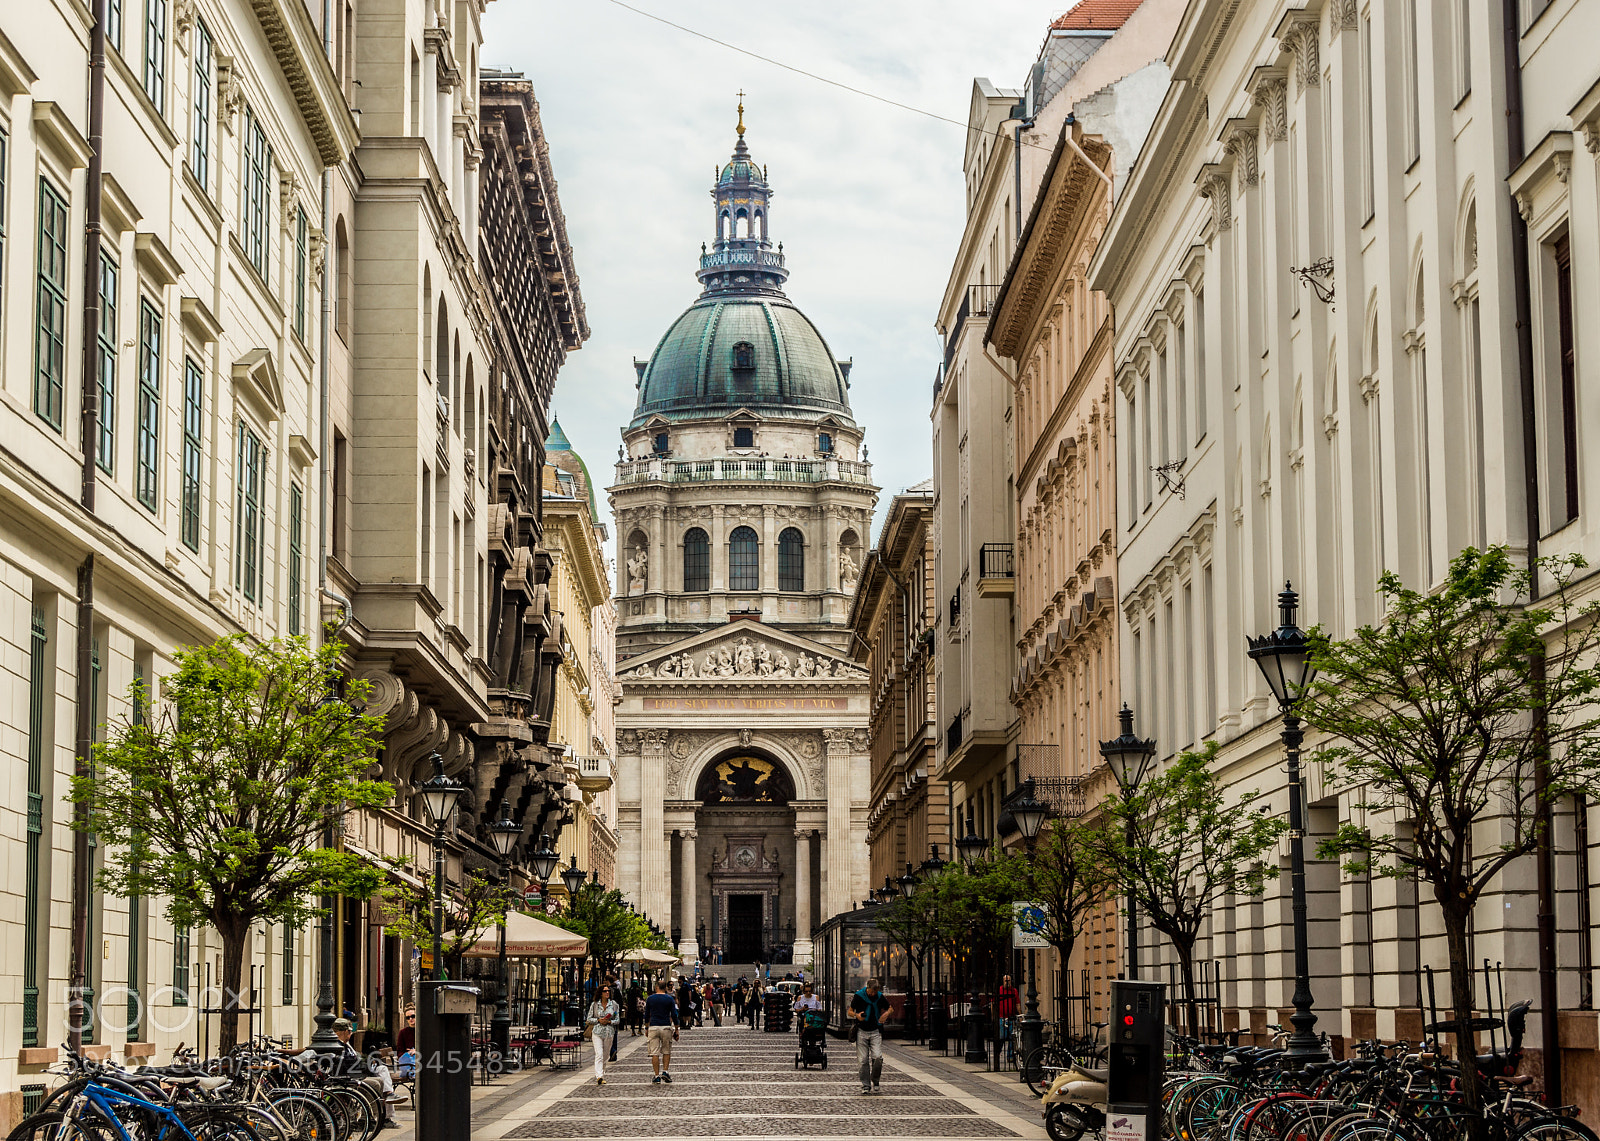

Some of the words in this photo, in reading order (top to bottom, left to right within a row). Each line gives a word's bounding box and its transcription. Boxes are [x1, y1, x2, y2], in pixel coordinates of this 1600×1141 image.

[655, 699, 677, 709] EGO
[684, 699, 708, 709] SUM
[717, 699, 735, 709] VIA
[741, 699, 786, 709] VERITAS
[793, 699, 805, 709] ET
[812, 699, 836, 709] VITA
